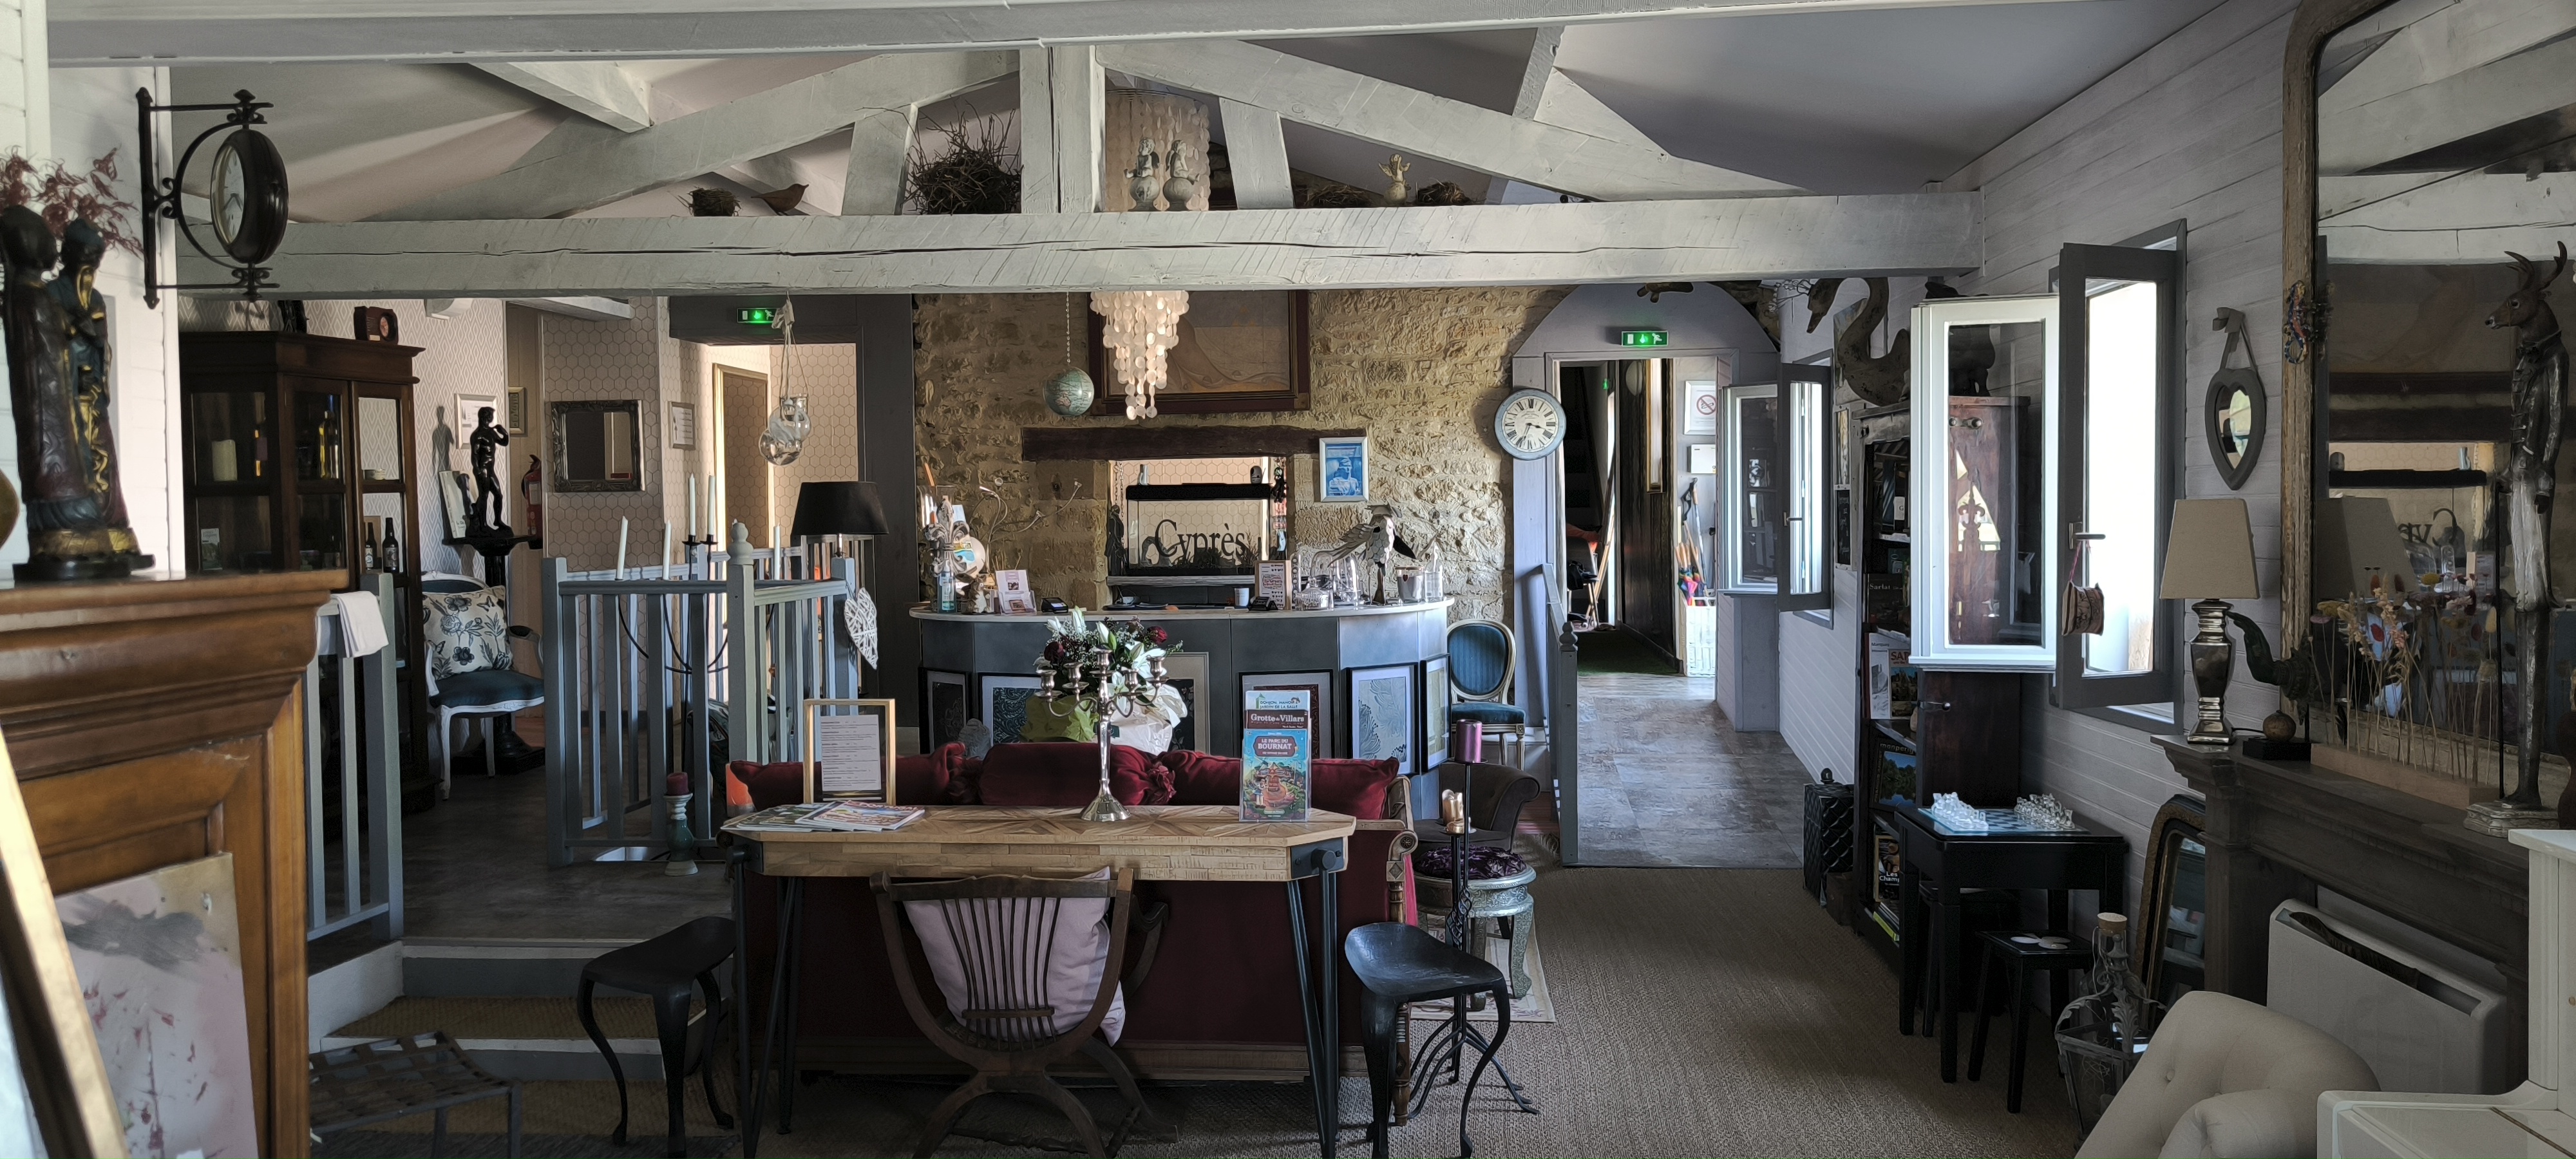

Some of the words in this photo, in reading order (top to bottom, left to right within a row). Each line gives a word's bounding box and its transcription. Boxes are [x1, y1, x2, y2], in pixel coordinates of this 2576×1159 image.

[1155, 519, 1245, 563] Cyprès
[1251, 713, 1275, 722] Grotte
[1280, 714, 1304, 722] Villars
